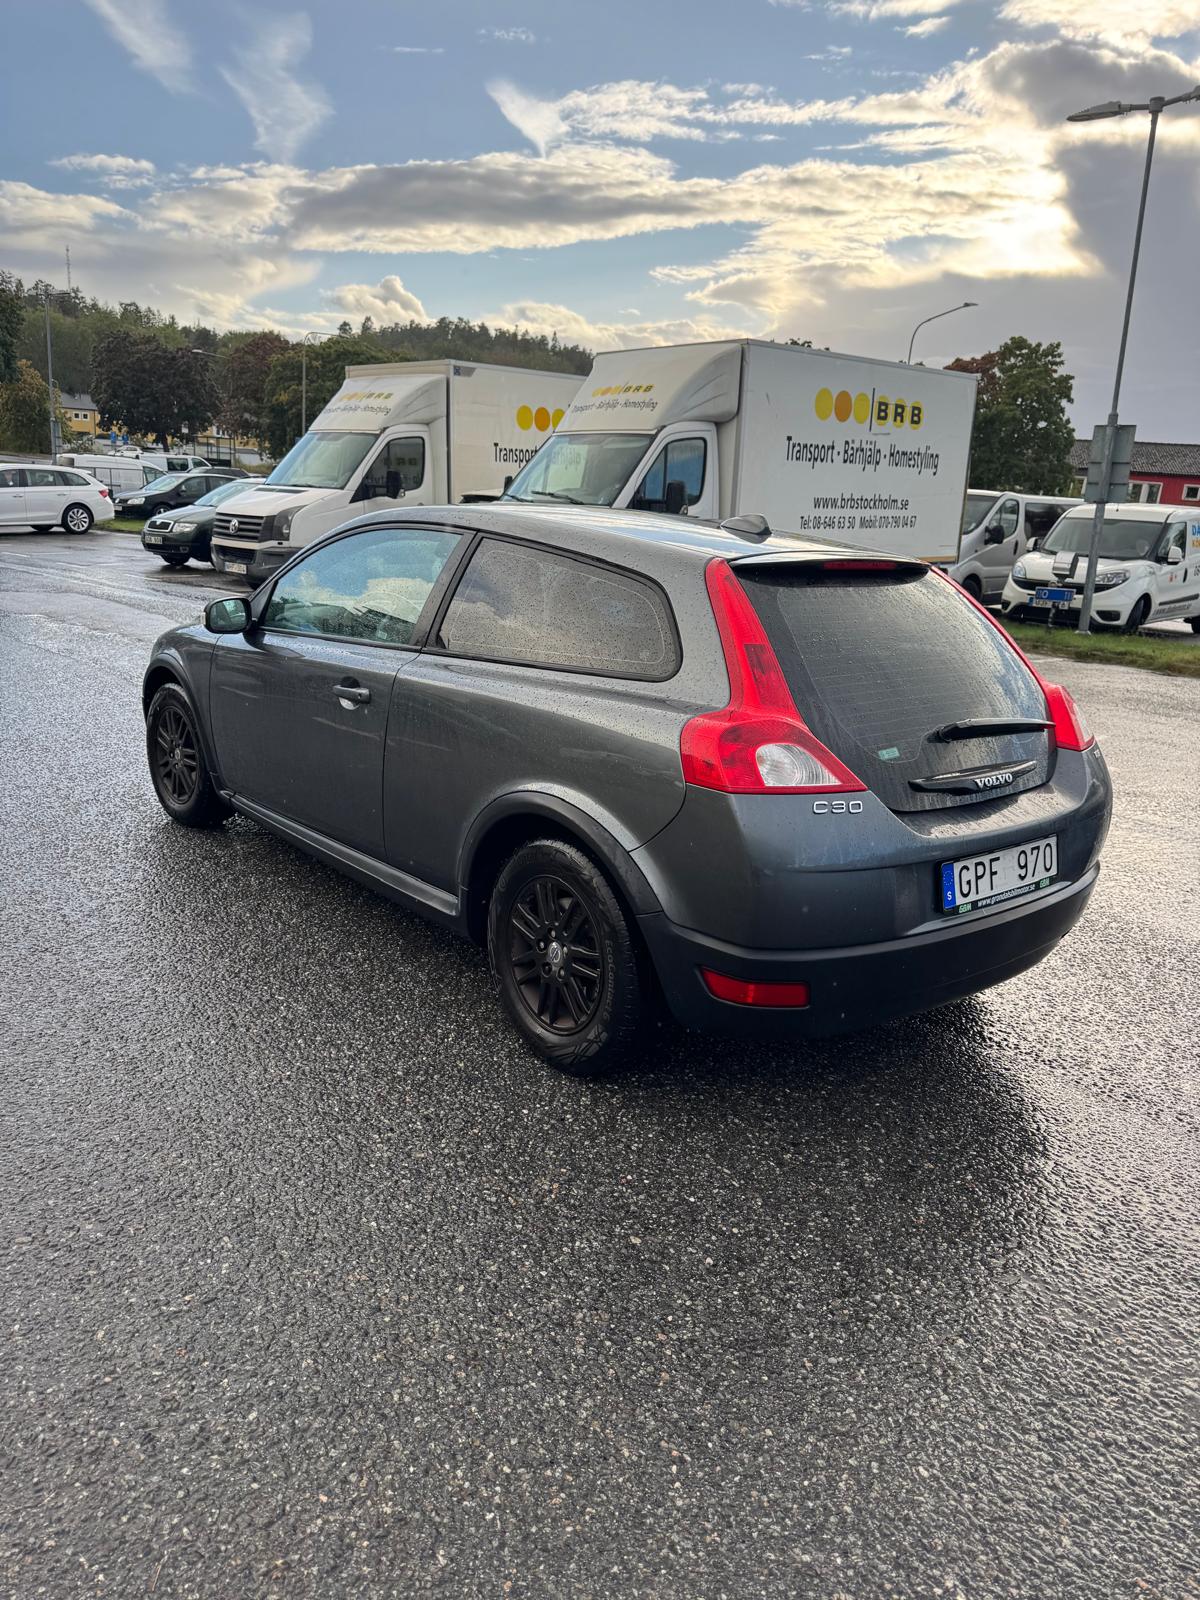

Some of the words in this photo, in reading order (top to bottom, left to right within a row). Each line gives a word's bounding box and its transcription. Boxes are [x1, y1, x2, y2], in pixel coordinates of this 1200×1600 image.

[623, 384, 654, 393] BRB
[877, 401, 922, 425] BRB
[785, 436, 835, 470] Transport
[842, 438, 882, 472] Bärhjälp
[889, 443, 940, 476] Homestyling
[813, 492, 909, 510] www.brbstockholm.se
[837, 515, 846, 529] 63
[847, 515, 856, 529] 50
[902, 515, 909, 528] 04
[909, 515, 917, 528] 67
[974, 772, 1013, 789] VOLVO
[813, 800, 864, 815] C30
[958, 856, 1001, 899] GPF
[1017, 842, 1053, 881] 970
[946, 890, 953, 901] S
